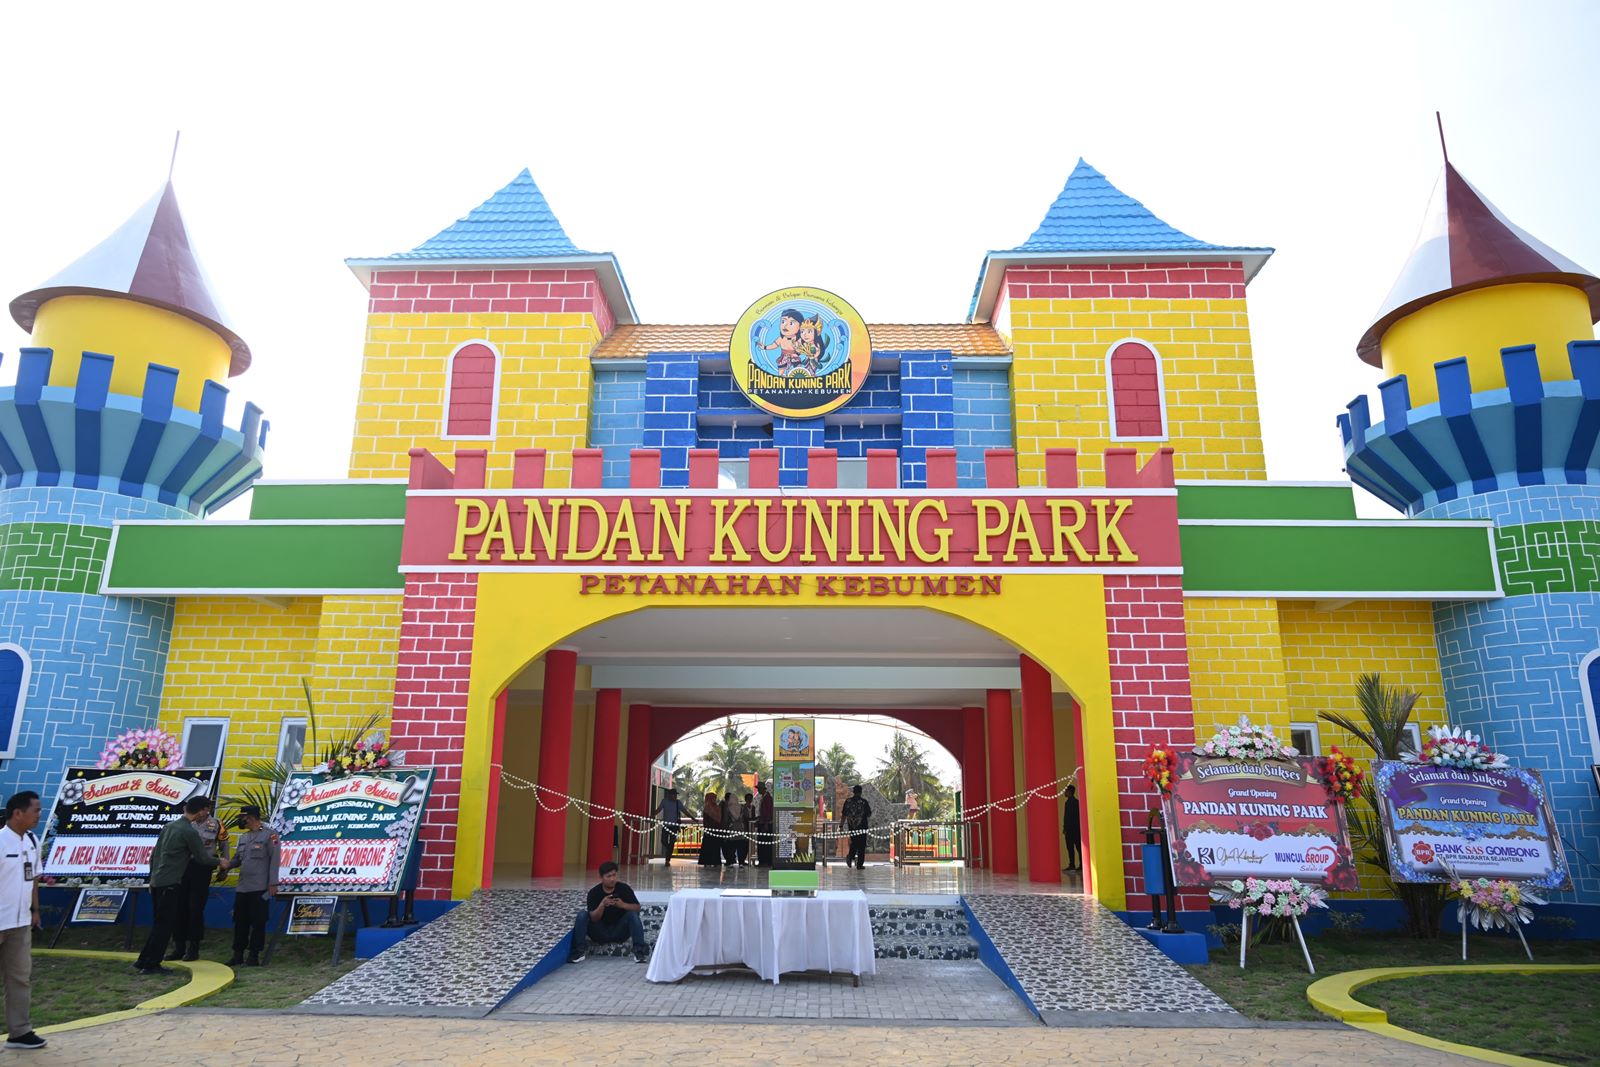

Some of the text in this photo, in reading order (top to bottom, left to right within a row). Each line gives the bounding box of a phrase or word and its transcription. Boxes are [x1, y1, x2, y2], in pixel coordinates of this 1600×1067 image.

[748, 363, 851, 389] PANDAN KUNING PARK
[448, 498, 1139, 563] PANDAN KUNING PARK
[579, 574, 1002, 597] PETANAHAN KEBUMEN
[1197, 762, 1301, 781] Selamat dan Sukses
[1408, 770, 1508, 788] Selamat dan Sukses
[82, 777, 181, 800] Selamat & Sukses
[302, 780, 399, 803] Selamat & Sukses
[1228, 788, 1277, 799] Grand Opening
[326, 801, 375, 811] PERESMIAN
[1182, 801, 1328, 819] PANDAN KUNING PARK
[1440, 796, 1487, 807] Grand Opening
[116, 813, 154, 821] KUNING
[158, 813, 184, 821] PARK
[292, 812, 397, 824] PANDAN KUNING PARK
[1397, 808, 1538, 826] PANDAN KUNING PARK
[300, 824, 339, 832] PETANAHAN
[52, 845, 155, 865] PT. ANEKA USAHA KEBUME
[280, 846, 387, 867] ONT ONE HOTEL GOMBONG
[1275, 852, 1329, 864] MUNCUL GROUP
[1434, 843, 1540, 858] BANK SAS GOMBONG
[289, 867, 357, 875] BY AZANA
